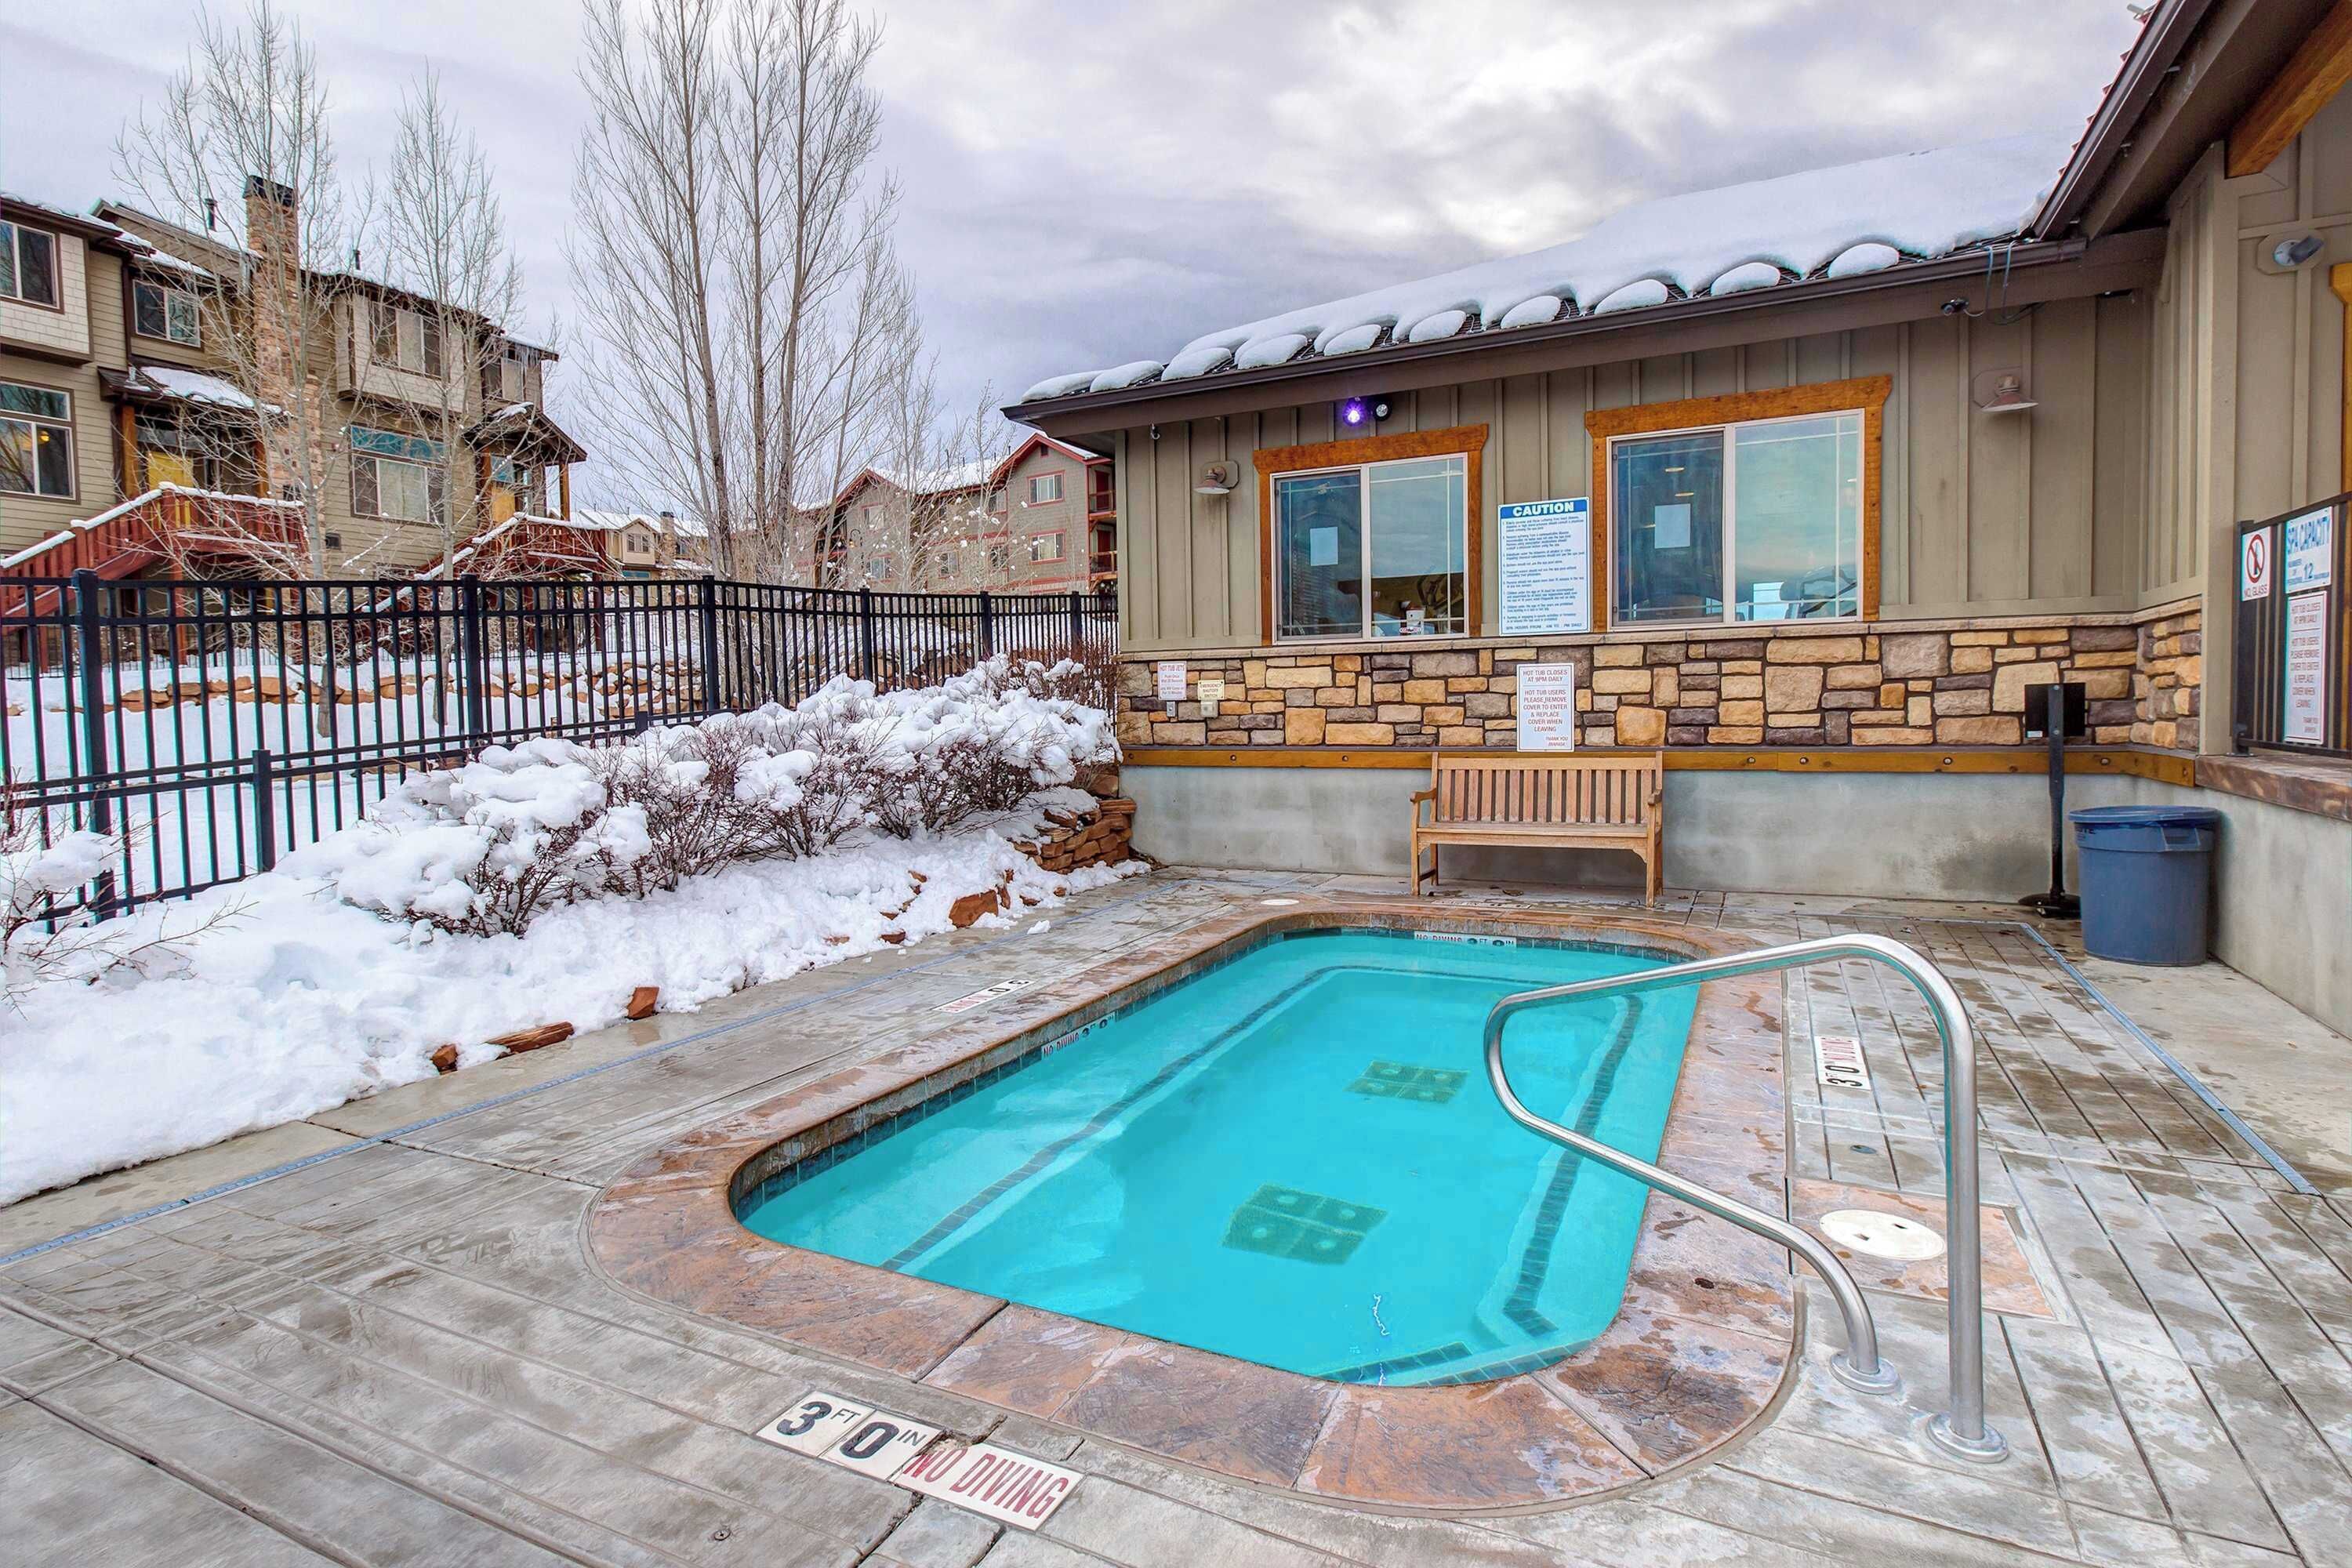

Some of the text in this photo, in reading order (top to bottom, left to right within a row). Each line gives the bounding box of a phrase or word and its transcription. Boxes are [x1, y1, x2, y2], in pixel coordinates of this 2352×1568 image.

[1512, 501, 1574, 517] CAUTION
[2303, 562, 2314, 579] 12
[2252, 584, 2268, 596] GLASS
[1044, 1044, 1054, 1056] NO
[1056, 1032, 1080, 1051] DIVING
[1824, 1065, 1860, 1074] 0
[1826, 1077, 1864, 1087] 3
[775, 1400, 1069, 1519] 3 FT 0 IN NO DIVING
